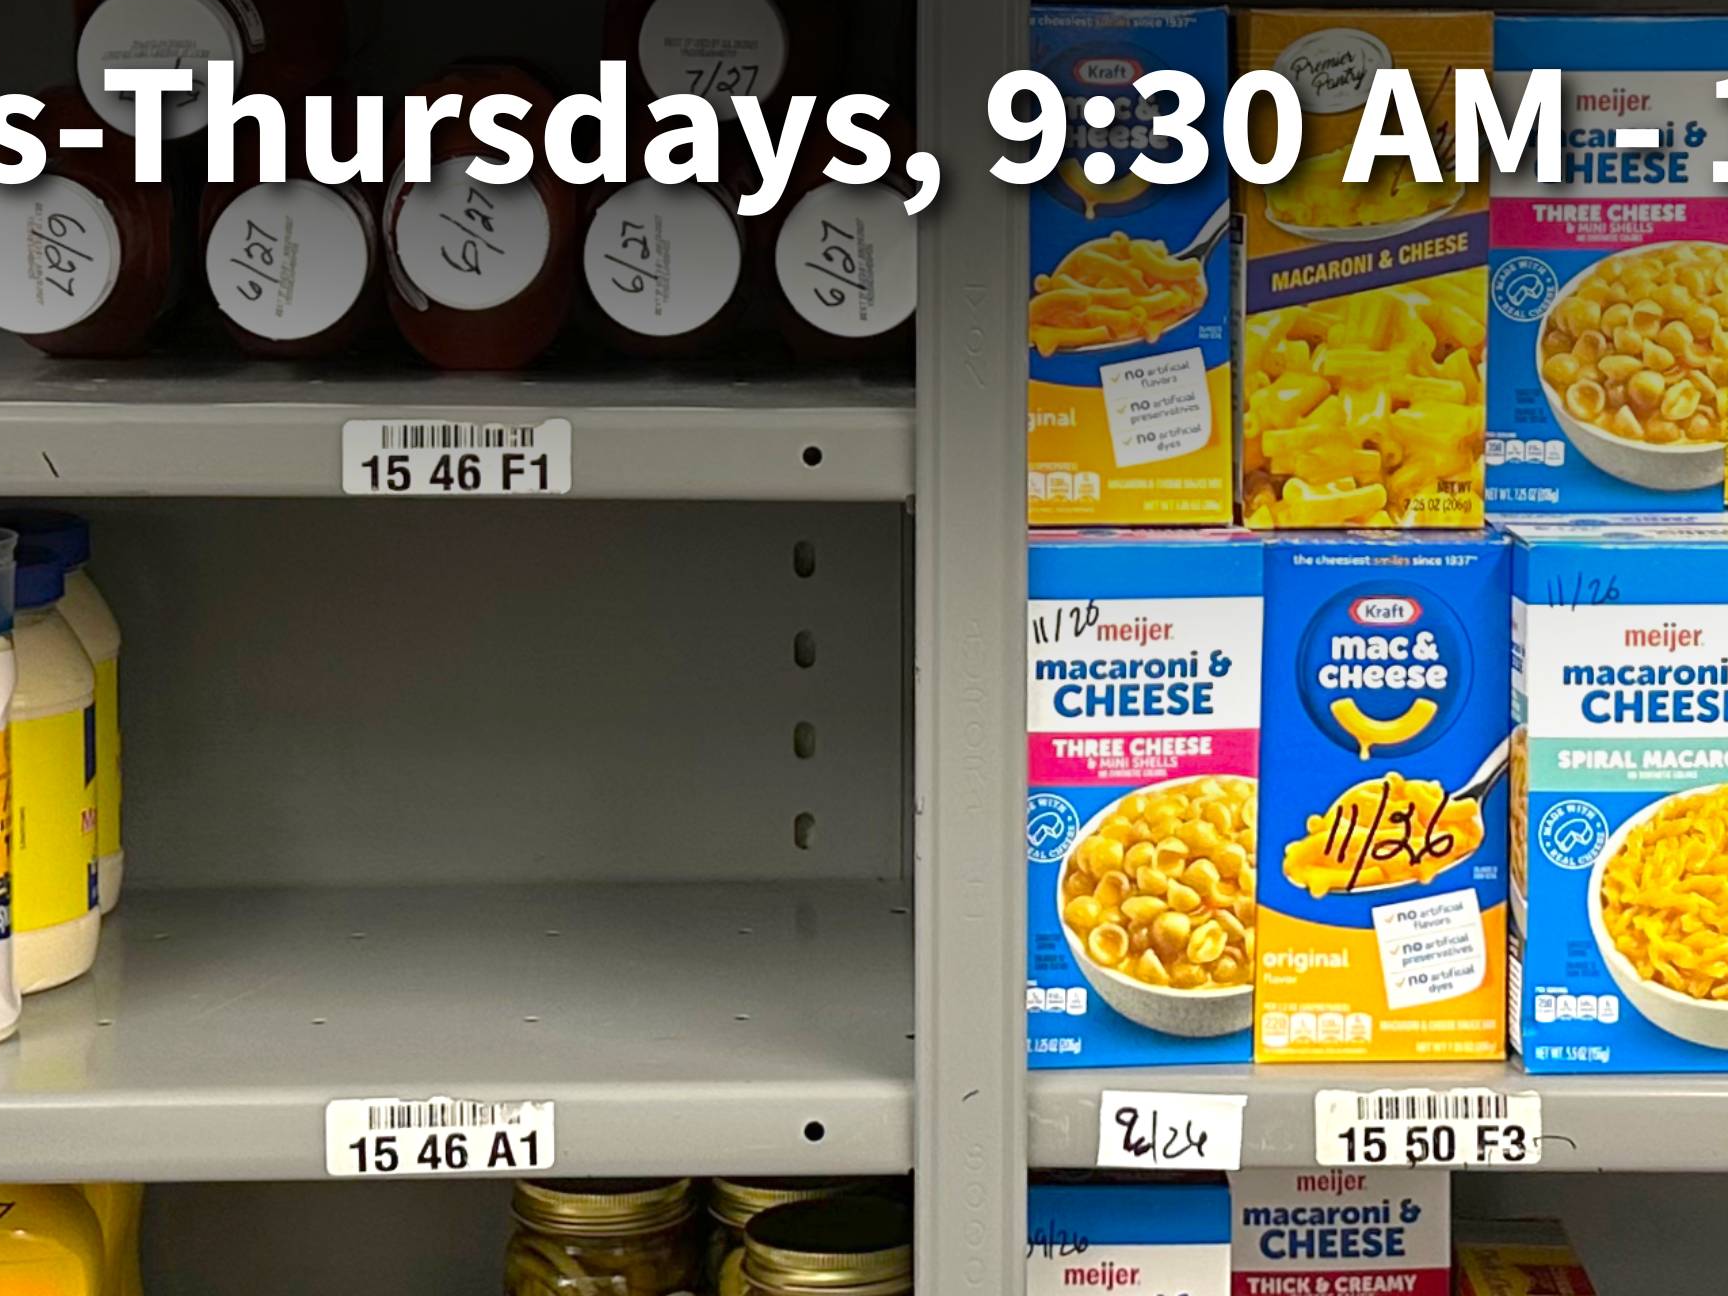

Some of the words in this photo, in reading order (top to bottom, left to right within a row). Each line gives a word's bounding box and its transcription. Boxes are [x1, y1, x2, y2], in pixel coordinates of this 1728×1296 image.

[1271, 256, 1372, 294] MACARONI
[1378, 248, 1394, 270] &
[1398, 231, 1470, 268] CHEESE
[361, 455, 412, 492] 15
[429, 454, 482, 491] 46
[502, 453, 551, 490] F1
[1365, 602, 1404, 620] Kraft
[1035, 651, 1199, 681] macaroni
[1208, 649, 1232, 675] &
[1052, 684, 1214, 718] CHEESE
[1052, 738, 1125, 758] THREE
[1129, 738, 1212, 756] CHEESE
[1397, 910, 1416, 922] no
[1262, 949, 1350, 972] original
[349, 1137, 399, 1173] 15
[417, 1133, 468, 1170] 46
[487, 1131, 540, 1168] A1
[1338, 1128, 1387, 1163] 15
[1405, 1126, 1456, 1164] 50
[1476, 1126, 1527, 1163] F3
[1246, 1276, 1310, 1296] THICK
[1314, 1276, 1333, 1294] &
[1336, 1275, 1419, 1294] CREAMY
